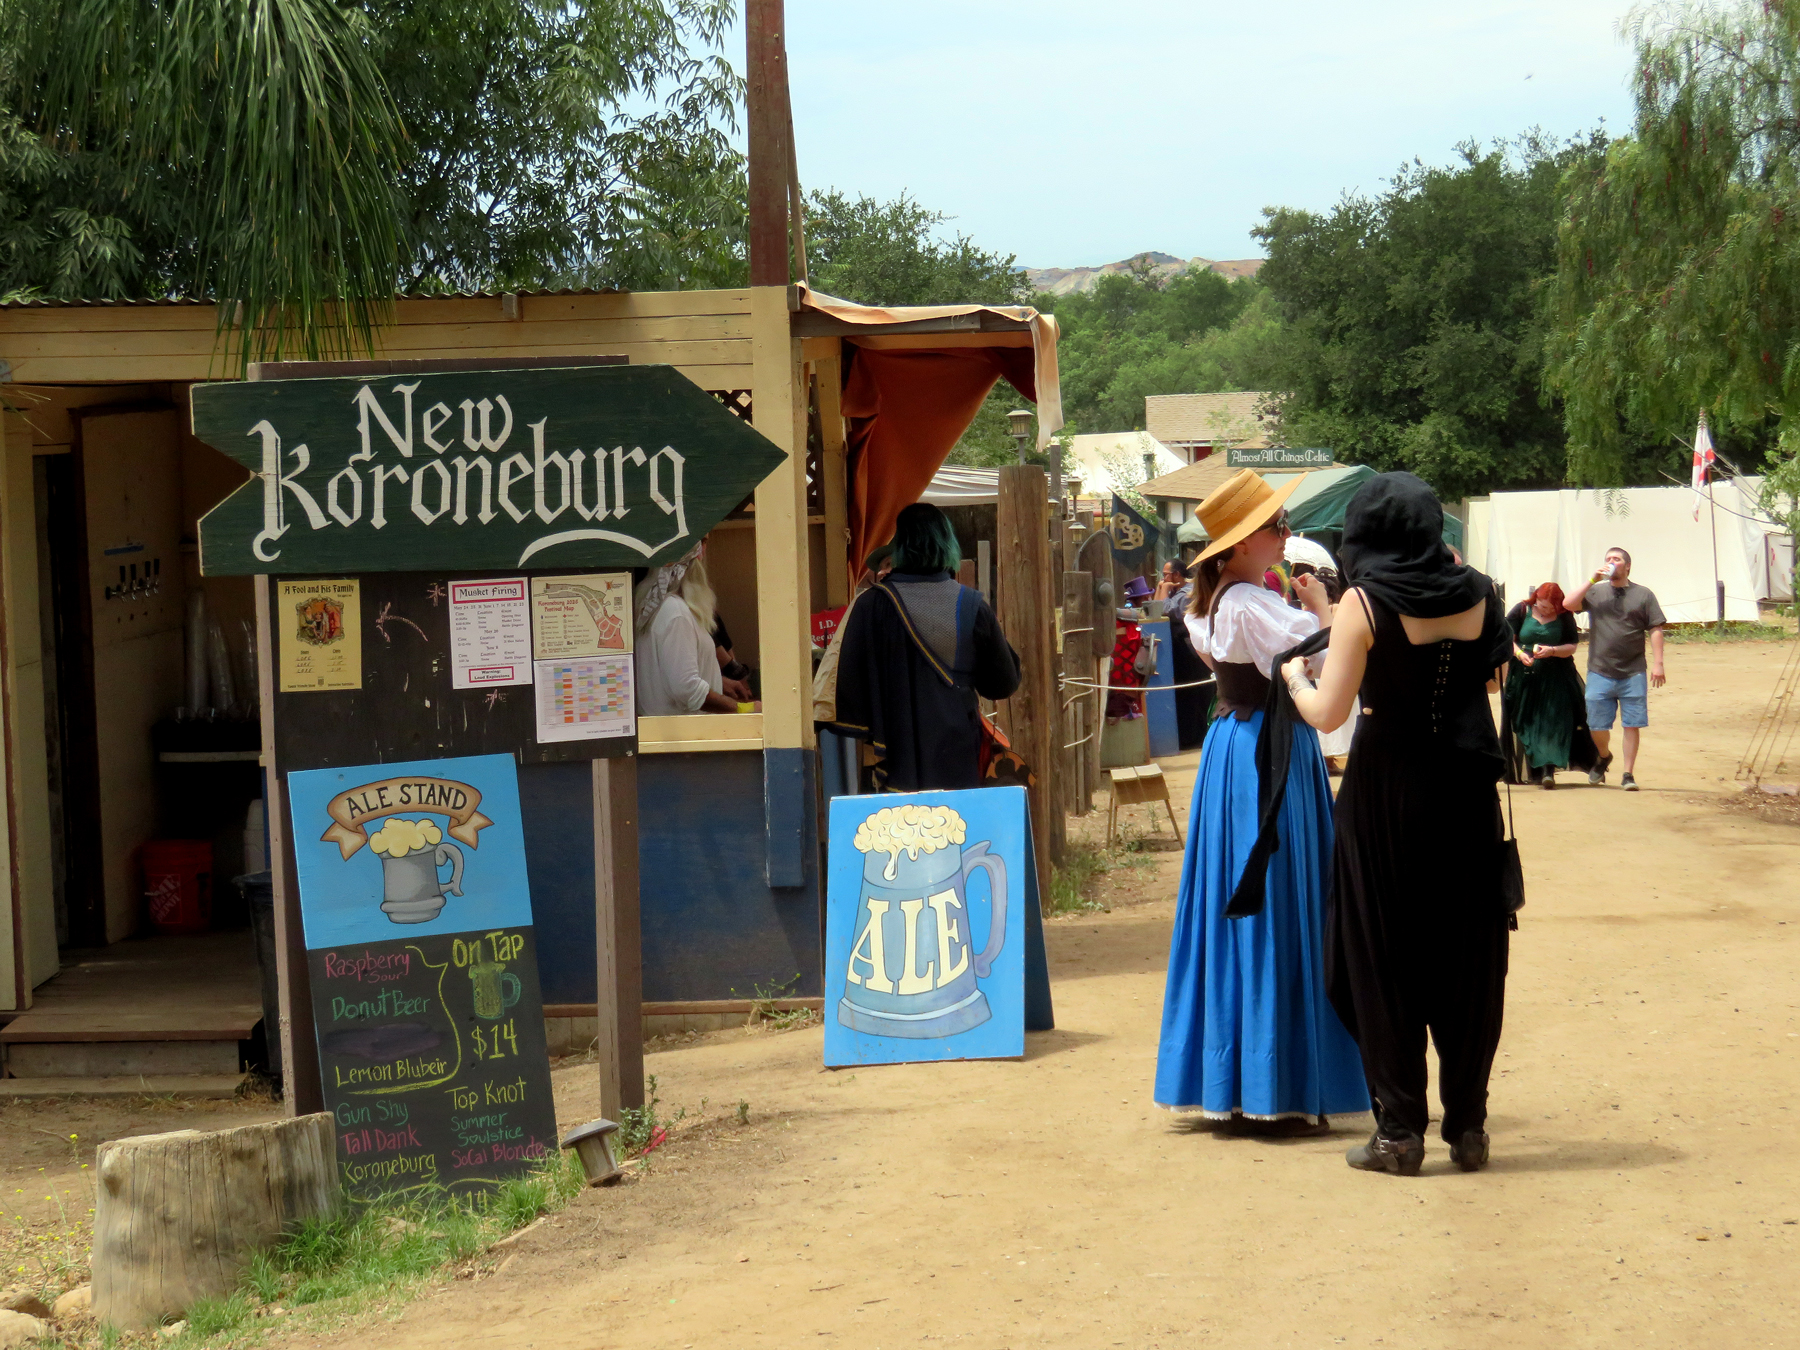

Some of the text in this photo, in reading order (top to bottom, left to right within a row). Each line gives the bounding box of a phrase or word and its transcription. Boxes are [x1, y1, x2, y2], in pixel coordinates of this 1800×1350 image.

[351, 379, 513, 466] New
[1231, 449, 1330, 464] Almost All Things Celtic
[246, 418, 690, 567] Koroneburg
[284, 585, 290, 594] A
[292, 585, 306, 594] Fool
[307, 585, 319, 593] and
[332, 585, 355, 593] Family
[460, 588, 488, 599] Musket
[819, 620, 836, 630] I.D.
[345, 783, 468, 820] ALE STAND
[452, 930, 525, 968] On Tap
[846, 887, 970, 996] ALE
[324, 950, 410, 981] Raspberry
[367, 970, 403, 983] Sour
[332, 987, 431, 1021] Donut Beer
[471, 1017, 519, 1060] $14
[335, 1064, 392, 1089] Lemon
[444, 1075, 527, 1112] Top Knot
[336, 1099, 409, 1127] Gun Shy
[450, 1112, 508, 1132] Summer
[340, 1123, 422, 1155] Tall Dank
[451, 1135, 546, 1169] SoCal Blonde
[341, 1152, 437, 1185] Koroneburg
